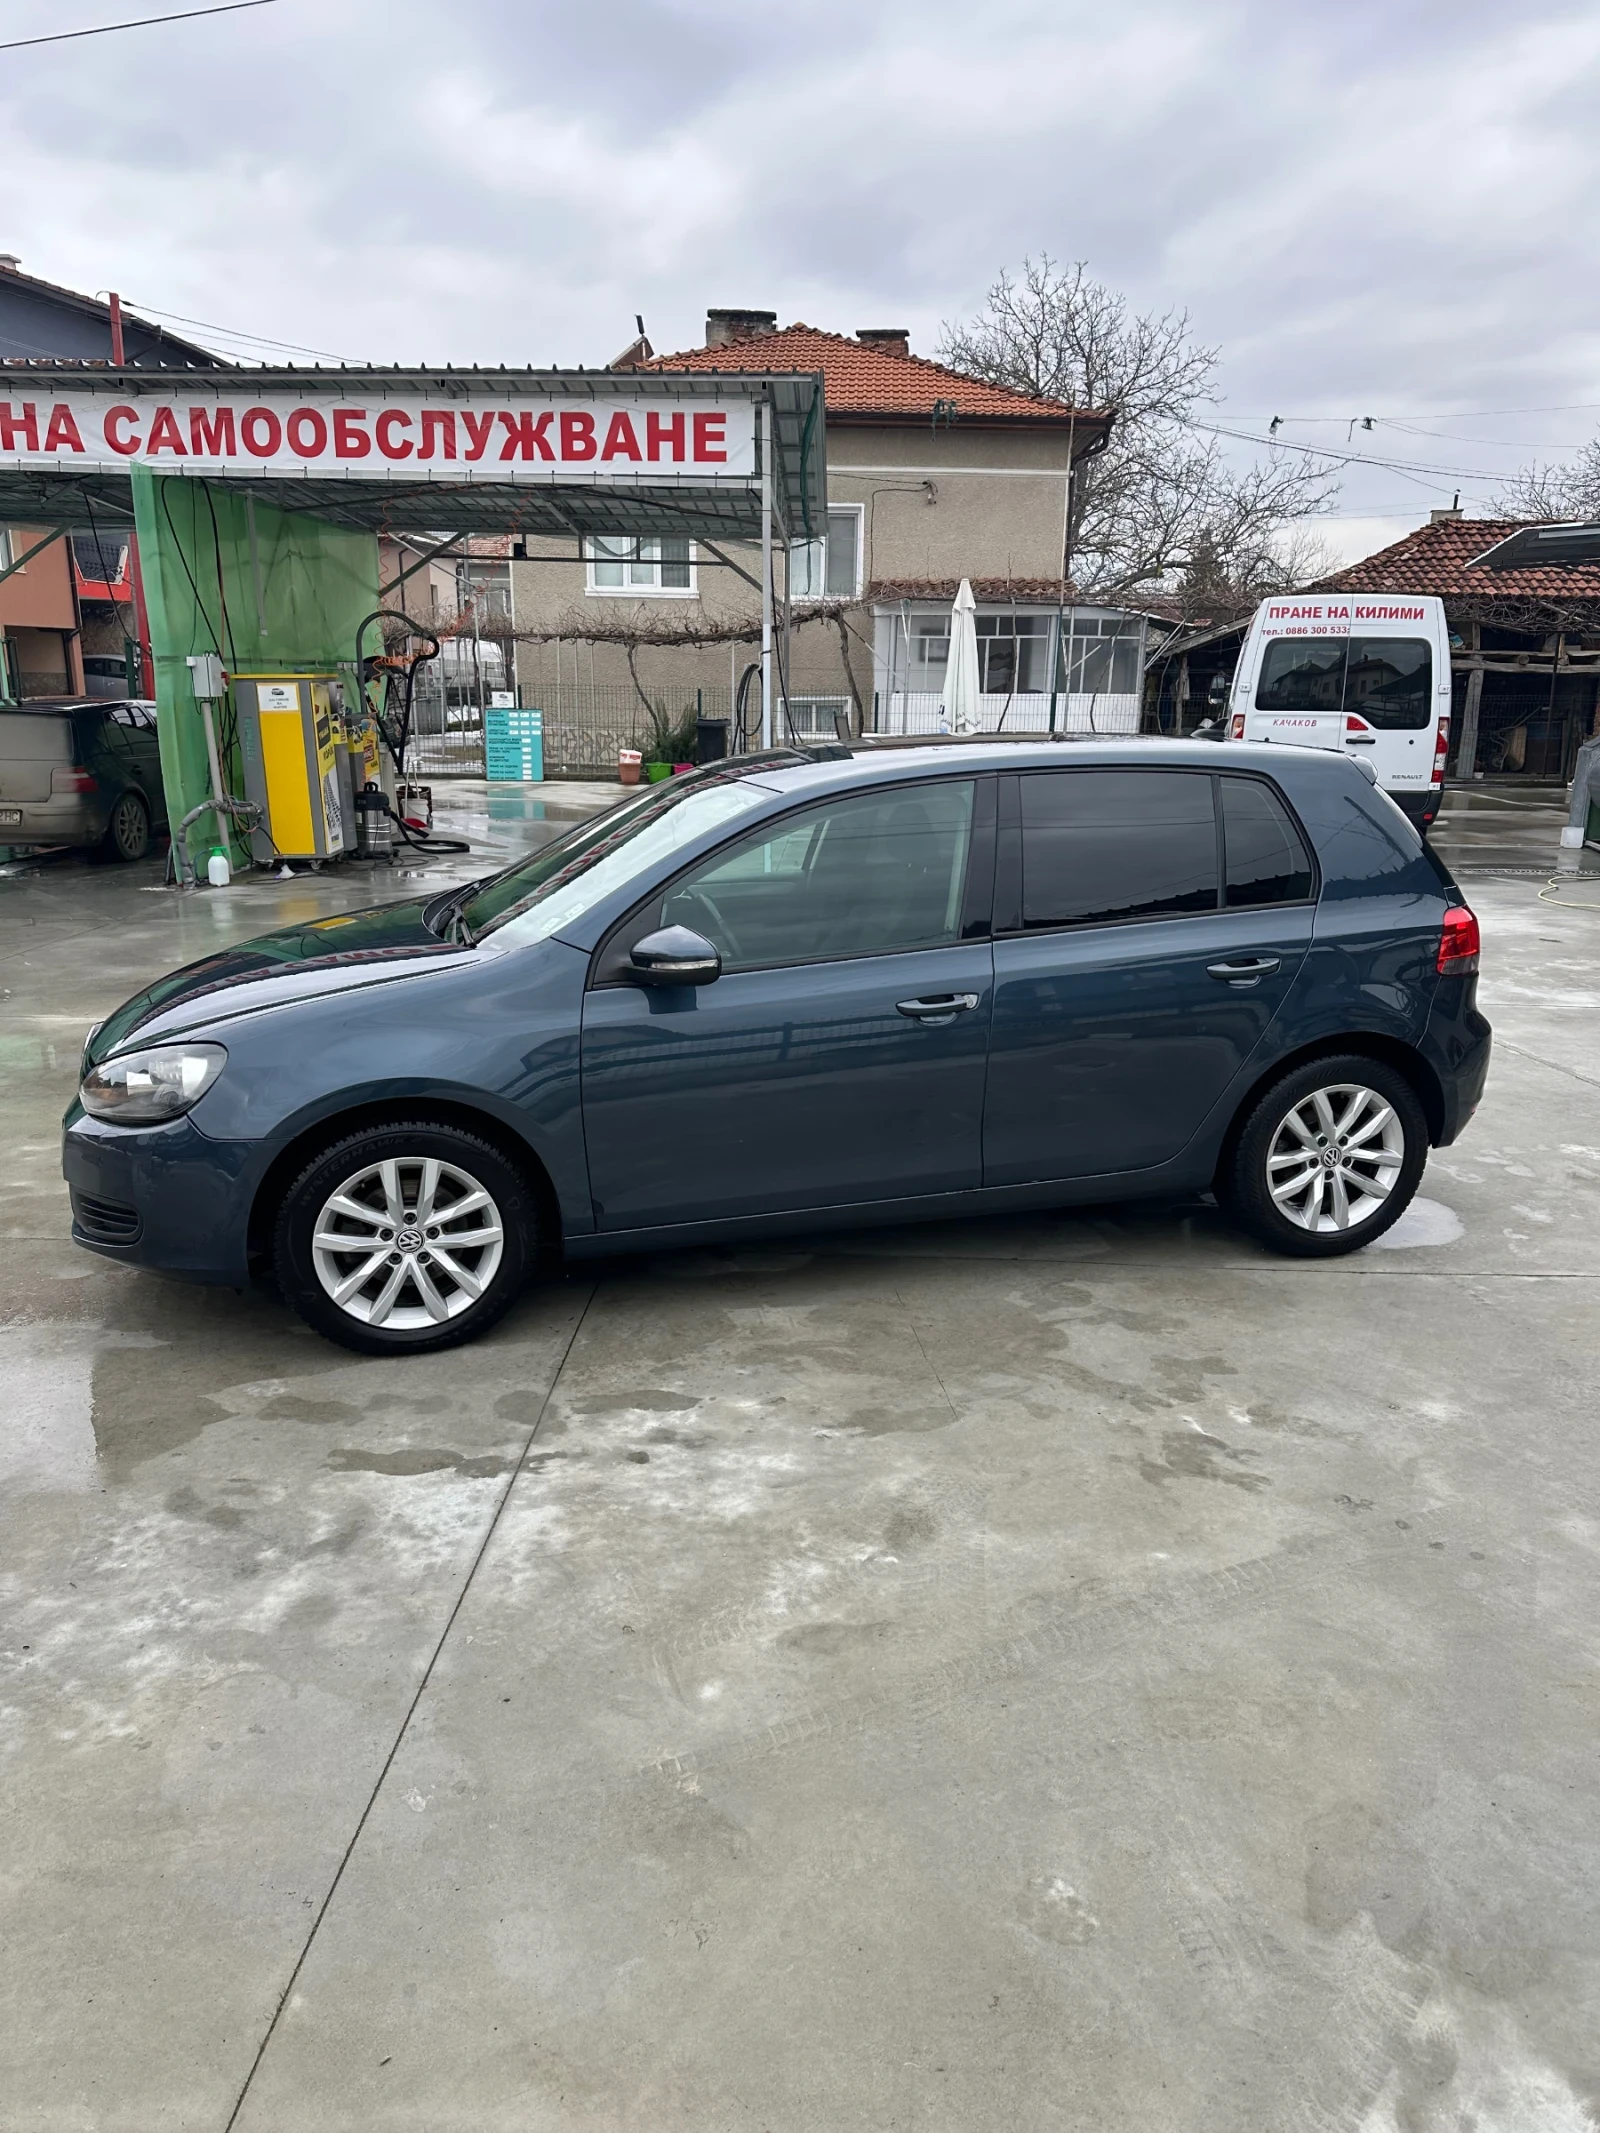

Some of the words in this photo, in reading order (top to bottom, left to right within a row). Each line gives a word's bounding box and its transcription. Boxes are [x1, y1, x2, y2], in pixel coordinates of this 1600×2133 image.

[0, 402, 86, 453] НА
[103, 405, 728, 464] САМООБСЛУЖВАНЕ
[1269, 606, 1323, 619] ПРАНЕ
[1327, 606, 1349, 619] НА
[1355, 606, 1424, 620] КИЛИМИ
[1285, 627, 1308, 635] 0886
[1310, 626, 1328, 635] 300
[1272, 719, 1318, 727] КАЧАКОВ
